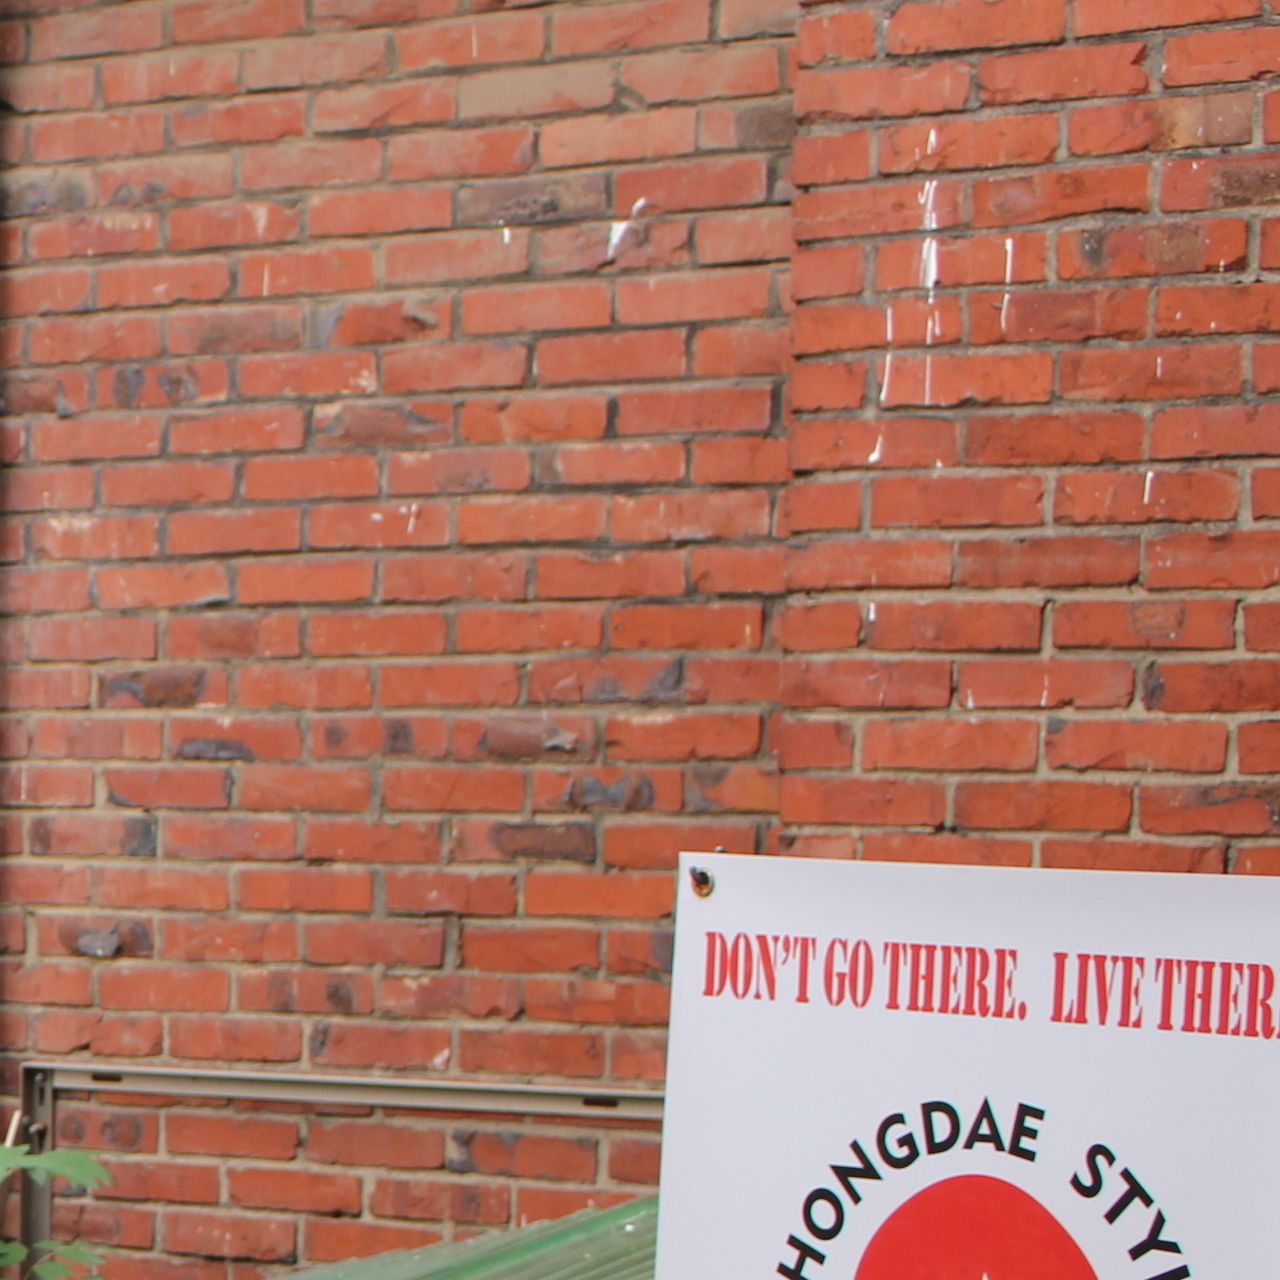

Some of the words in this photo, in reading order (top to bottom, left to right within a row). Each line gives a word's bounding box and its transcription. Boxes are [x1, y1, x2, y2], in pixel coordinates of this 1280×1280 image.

[702, 931, 817, 1004] DON'T
[823, 938, 874, 1008] GO
[883, 941, 1027, 1021] THERE.
[1050, 952, 1145, 1029] LIVE
[1155, 958, 1280, 1040] THER
